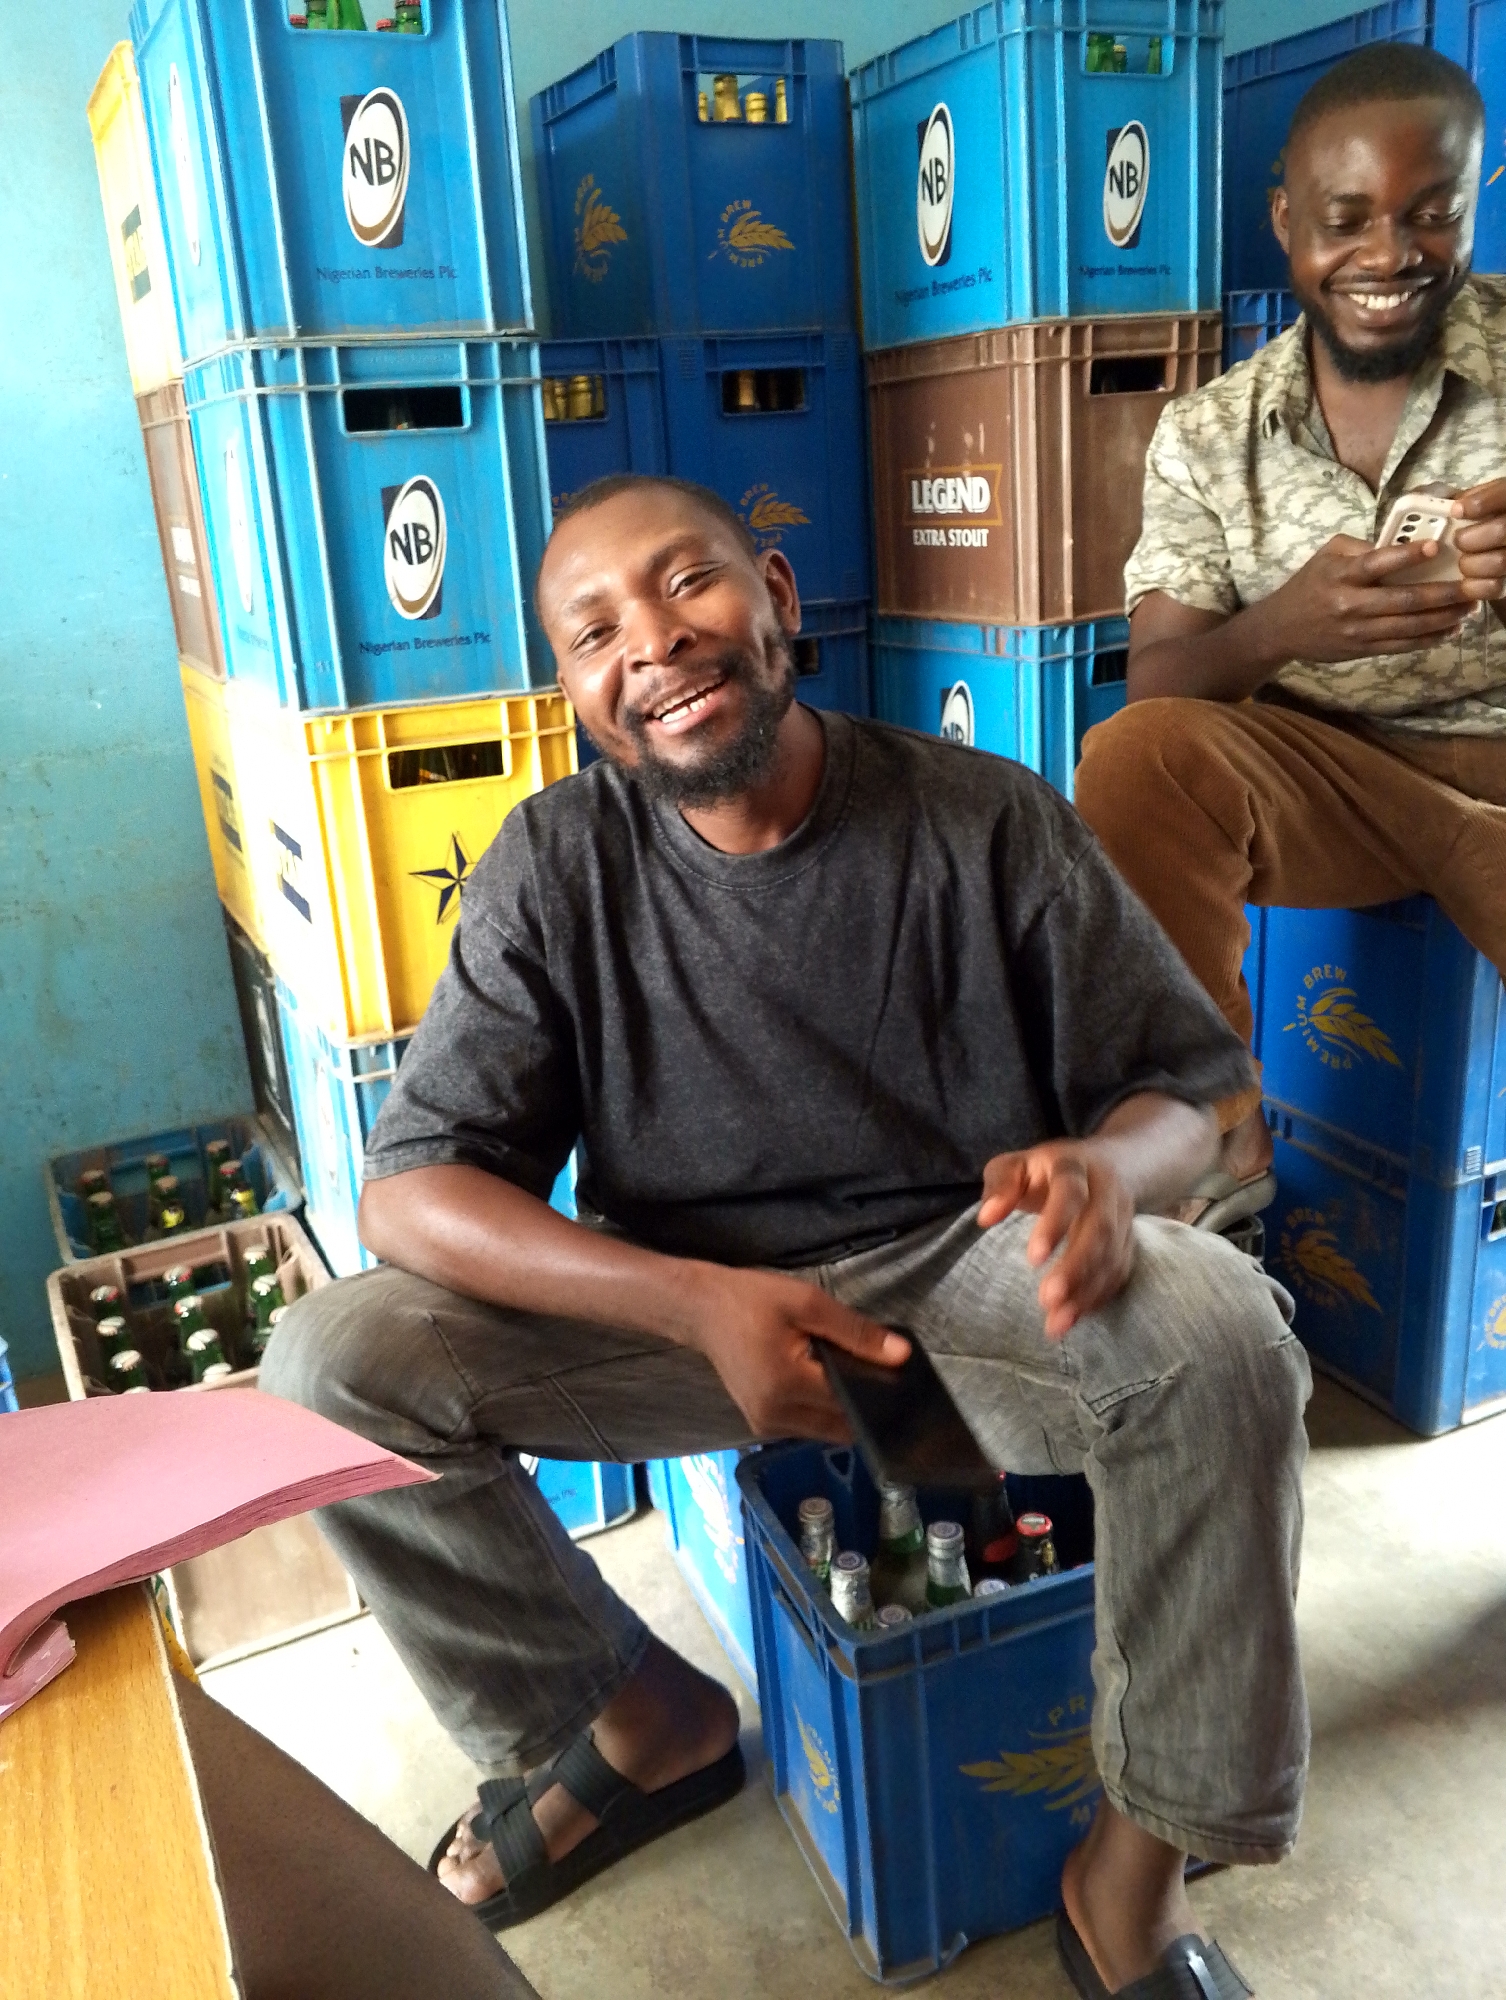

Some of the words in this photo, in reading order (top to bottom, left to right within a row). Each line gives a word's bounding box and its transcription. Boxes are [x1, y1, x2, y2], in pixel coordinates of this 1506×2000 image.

[349, 137, 396, 186] NB
[921, 157, 946, 206] NB
[1109, 160, 1139, 199] NB
[720, 199, 752, 223] BREW
[316, 267, 371, 283] Nigerian
[374, 266, 435, 279] Breweries
[439, 265, 457, 279] Plc
[978, 267, 993, 284] Plc
[911, 475, 992, 514] LEGEND
[389, 522, 434, 566] NB
[912, 528, 948, 547] EXTRA
[948, 528, 990, 548] STOUT
[359, 641, 411, 656] Nigerian
[413, 636, 472, 650] Breweries
[1303, 963, 1347, 990] BREW
[1296, 994, 1353, 1071] PREMIUM
